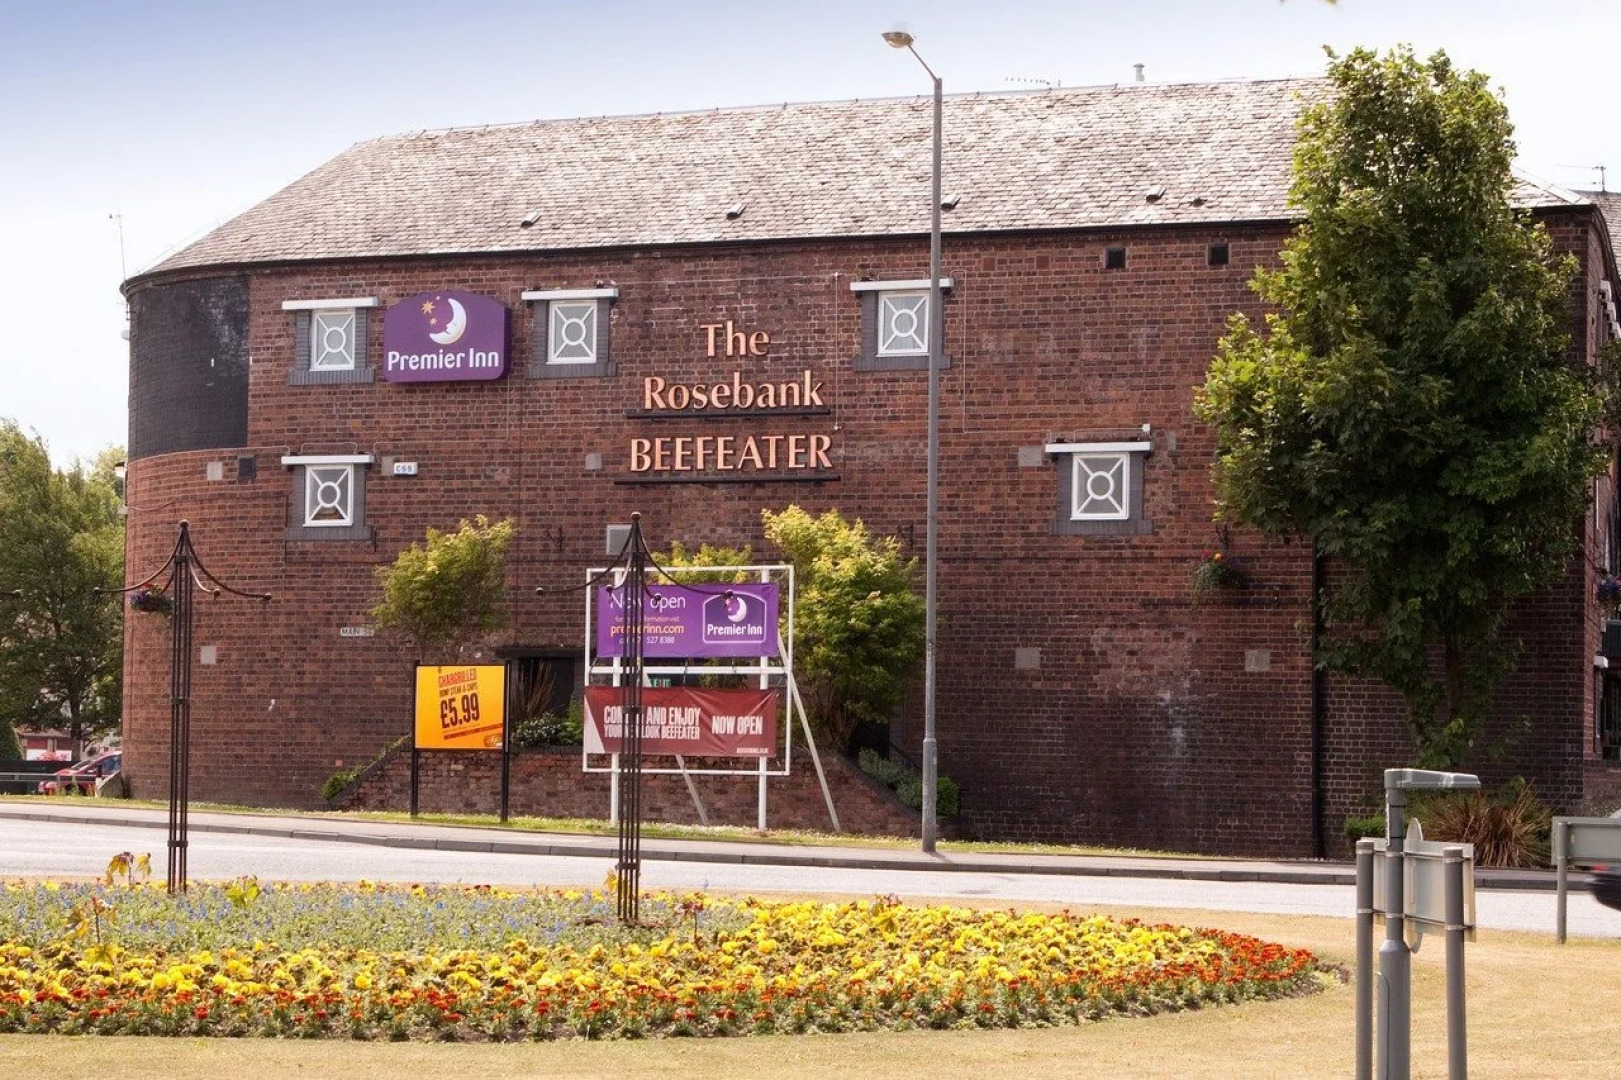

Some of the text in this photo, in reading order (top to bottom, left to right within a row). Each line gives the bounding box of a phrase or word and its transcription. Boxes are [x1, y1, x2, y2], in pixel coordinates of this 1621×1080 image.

[700, 320, 770, 358] The
[387, 347, 499, 371] Premier Inn
[644, 370, 824, 410] Rosebank
[630, 434, 833, 472] BEEFEATER
[650, 594, 686, 613] open
[707, 623, 762, 635] Premier Inn
[646, 636, 658, 644] 527
[440, 692, 480, 729] £5.99
[646, 706, 666, 725] AND
[668, 706, 701, 726] ENJOY
[603, 723, 623, 738] YOUR
[641, 725, 660, 739] LOOK
[661, 726, 700, 740] BEEFEATER
[711, 715, 763, 735] NOW OPEN
